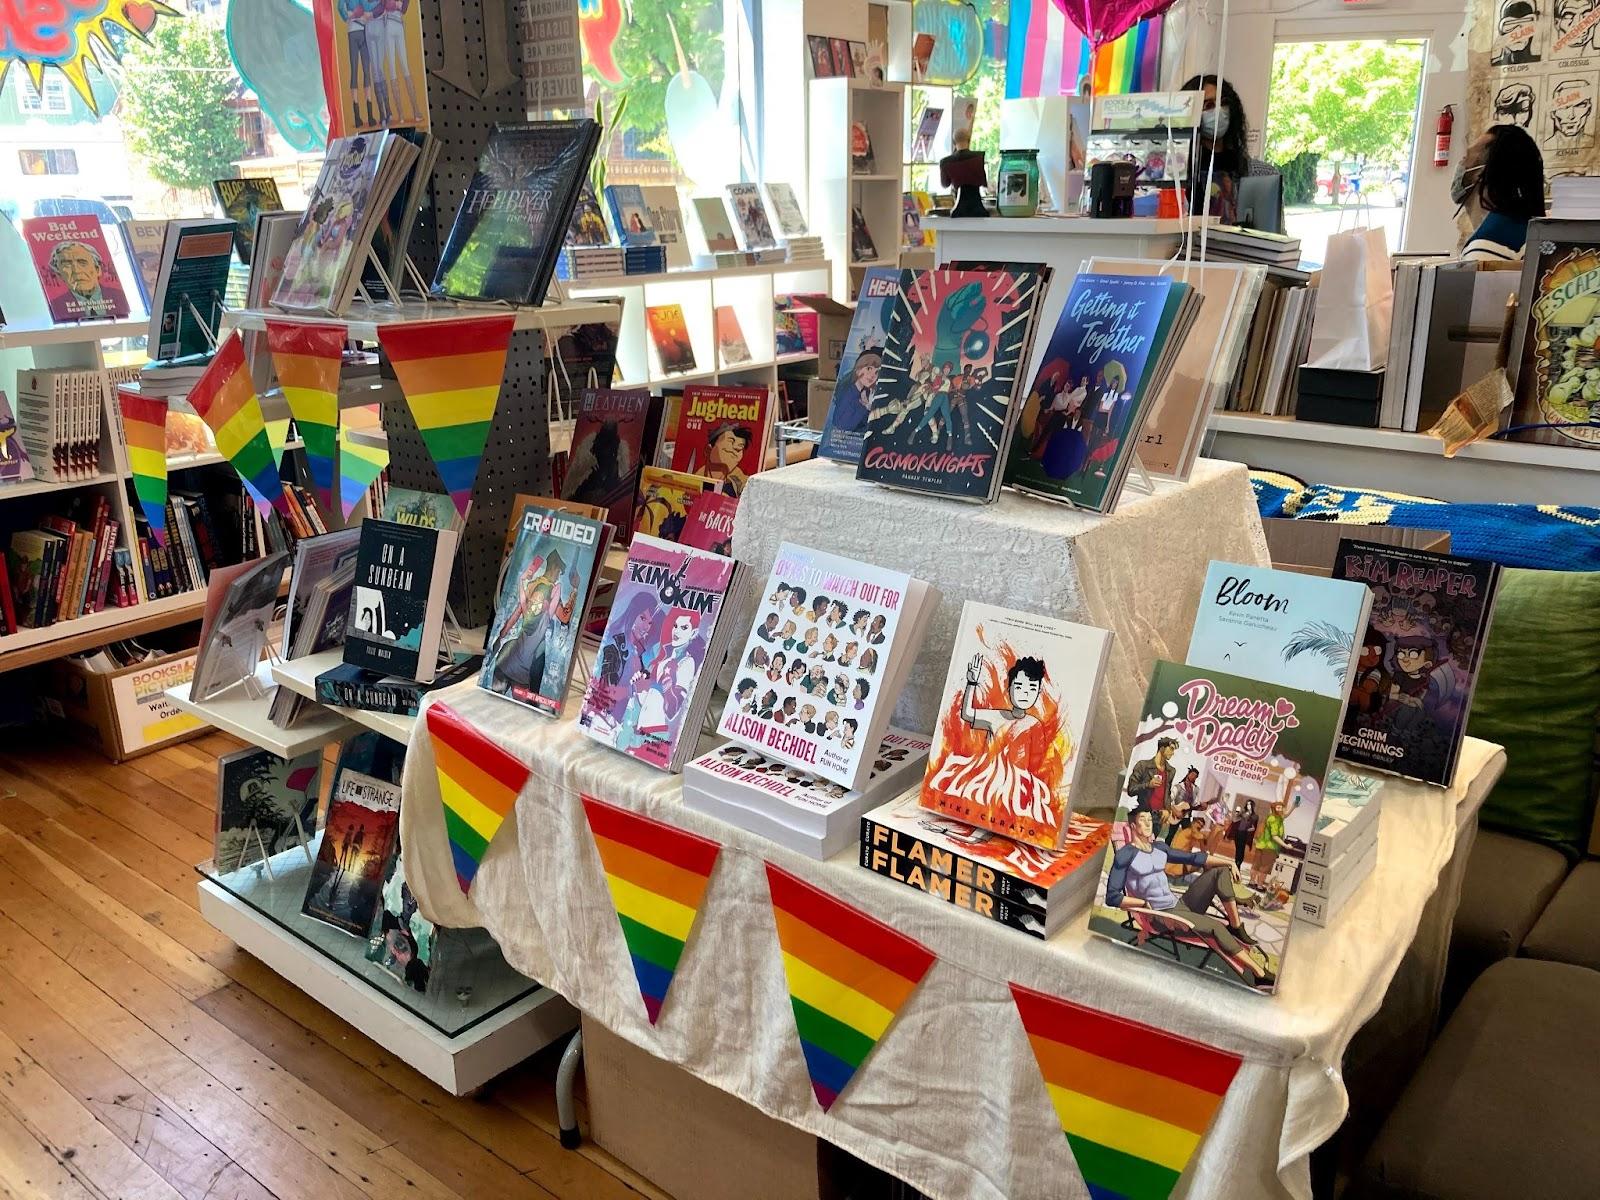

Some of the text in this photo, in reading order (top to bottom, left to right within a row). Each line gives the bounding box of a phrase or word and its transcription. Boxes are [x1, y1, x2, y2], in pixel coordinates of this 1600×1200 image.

[1510, 24, 1536, 42] SLAIN
[1502, 64, 1529, 73] CYCLOPS
[1558, 59, 1590, 68] COLOSSUS
[1556, 91, 1582, 106] SLAIN
[32, 229, 99, 241] Weekend
[48, 221, 77, 231] Bad
[1538, 270, 1600, 321] ESCAP
[1071, 289, 1146, 333] Getting it
[1077, 321, 1145, 364] Together
[583, 392, 645, 412] HEATHEN
[686, 396, 760, 422] Jughead
[686, 422, 702, 430] ONE
[396, 511, 436, 528] WILDS
[523, 512, 596, 545] CROWDED
[381, 543, 405, 567] ON A
[368, 564, 413, 592] SUNBEAM
[629, 563, 670, 590] KIM
[1395, 562, 1477, 598] REAPER
[674, 589, 716, 616] KIM
[823, 572, 860, 598] WATCH
[860, 582, 881, 604] OUT
[880, 588, 900, 610] FOR
[1216, 576, 1289, 614] Bloom
[344, 687, 353, 701] ON
[357, 689, 361, 703] A
[365, 690, 397, 707] SUNBEAM
[1178, 679, 1285, 732] Dream
[725, 713, 818, 764] ALISON BECHDEL
[883, 734, 931, 750] OUT FOR
[1191, 716, 1279, 761] Daddy
[1358, 727, 1388, 742] GRIM
[820, 757, 848, 775] FUN HOME
[824, 749, 843, 761] Author
[1220, 755, 1237, 766] Dad
[1238, 760, 1268, 776] Dating
[698, 756, 797, 797] ALISON BECHDEL
[1213, 763, 1263, 781] Comic Book
[341, 779, 356, 797] LIFE
[362, 785, 394, 807] STRANGE
[802, 793, 823, 803] Author
[929, 751, 1057, 829] FLAMER
[807, 799, 827, 809] HOME
[939, 800, 1036, 836] MIKE CURATO
[873, 824, 996, 893] FLAMER
[872, 849, 994, 919] FLAMER
